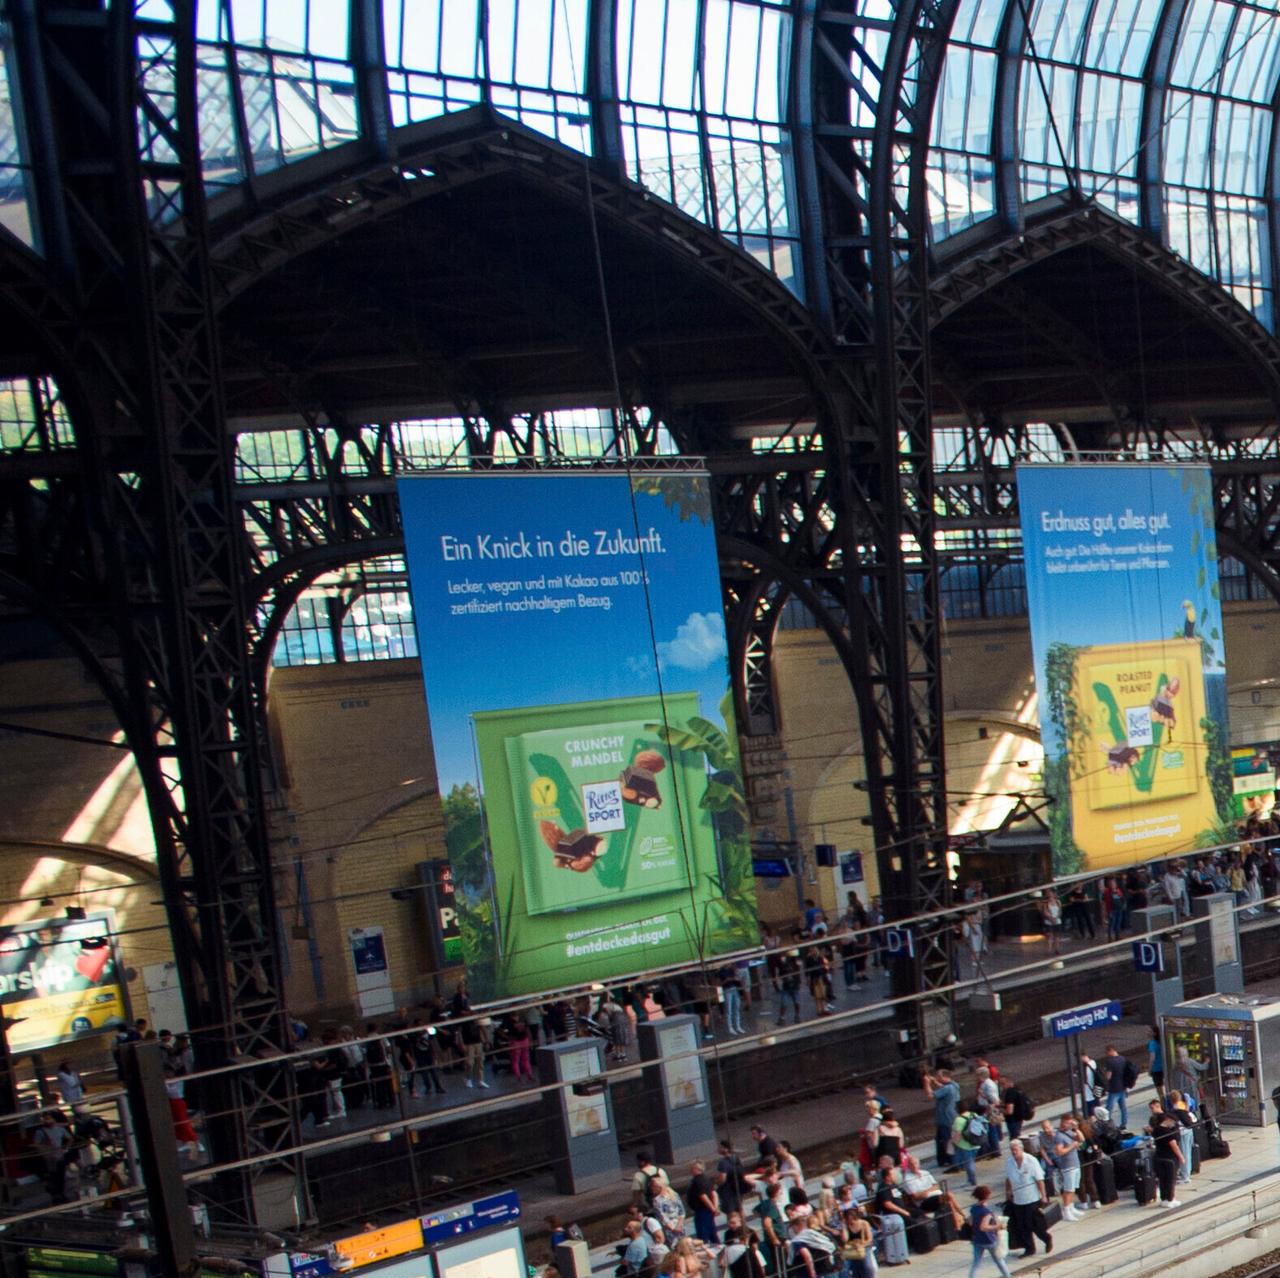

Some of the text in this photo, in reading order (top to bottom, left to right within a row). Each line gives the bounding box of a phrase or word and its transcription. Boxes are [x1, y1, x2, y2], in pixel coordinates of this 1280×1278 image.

[1040, 508, 1172, 537] Erdnuss gut, alles gut.
[441, 527, 667, 561] Ein Knick in die Zukunft.
[448, 578, 484, 595] Lecker,
[487, 579, 523, 596] vegan
[525, 576, 545, 591] und
[548, 575, 563, 589] mit
[565, 574, 598, 588] Kakao
[601, 576, 619, 587] aus
[451, 594, 614, 615] zertifiziert nachhaltigem Bezug.
[1116, 671, 1152, 681] ROASTED
[1120, 682, 1151, 695] PEANUT
[565, 736, 624, 753] CRUNCHY
[571, 750, 624, 768] MANDEL
[588, 808, 621, 822] SPORT
[566, 927, 671, 958] #entdeckedasgut
[887, 930, 901, 952] D
[1141, 944, 1156, 966] D
[1057, 1006, 1108, 1031] Hamburg Hbf
